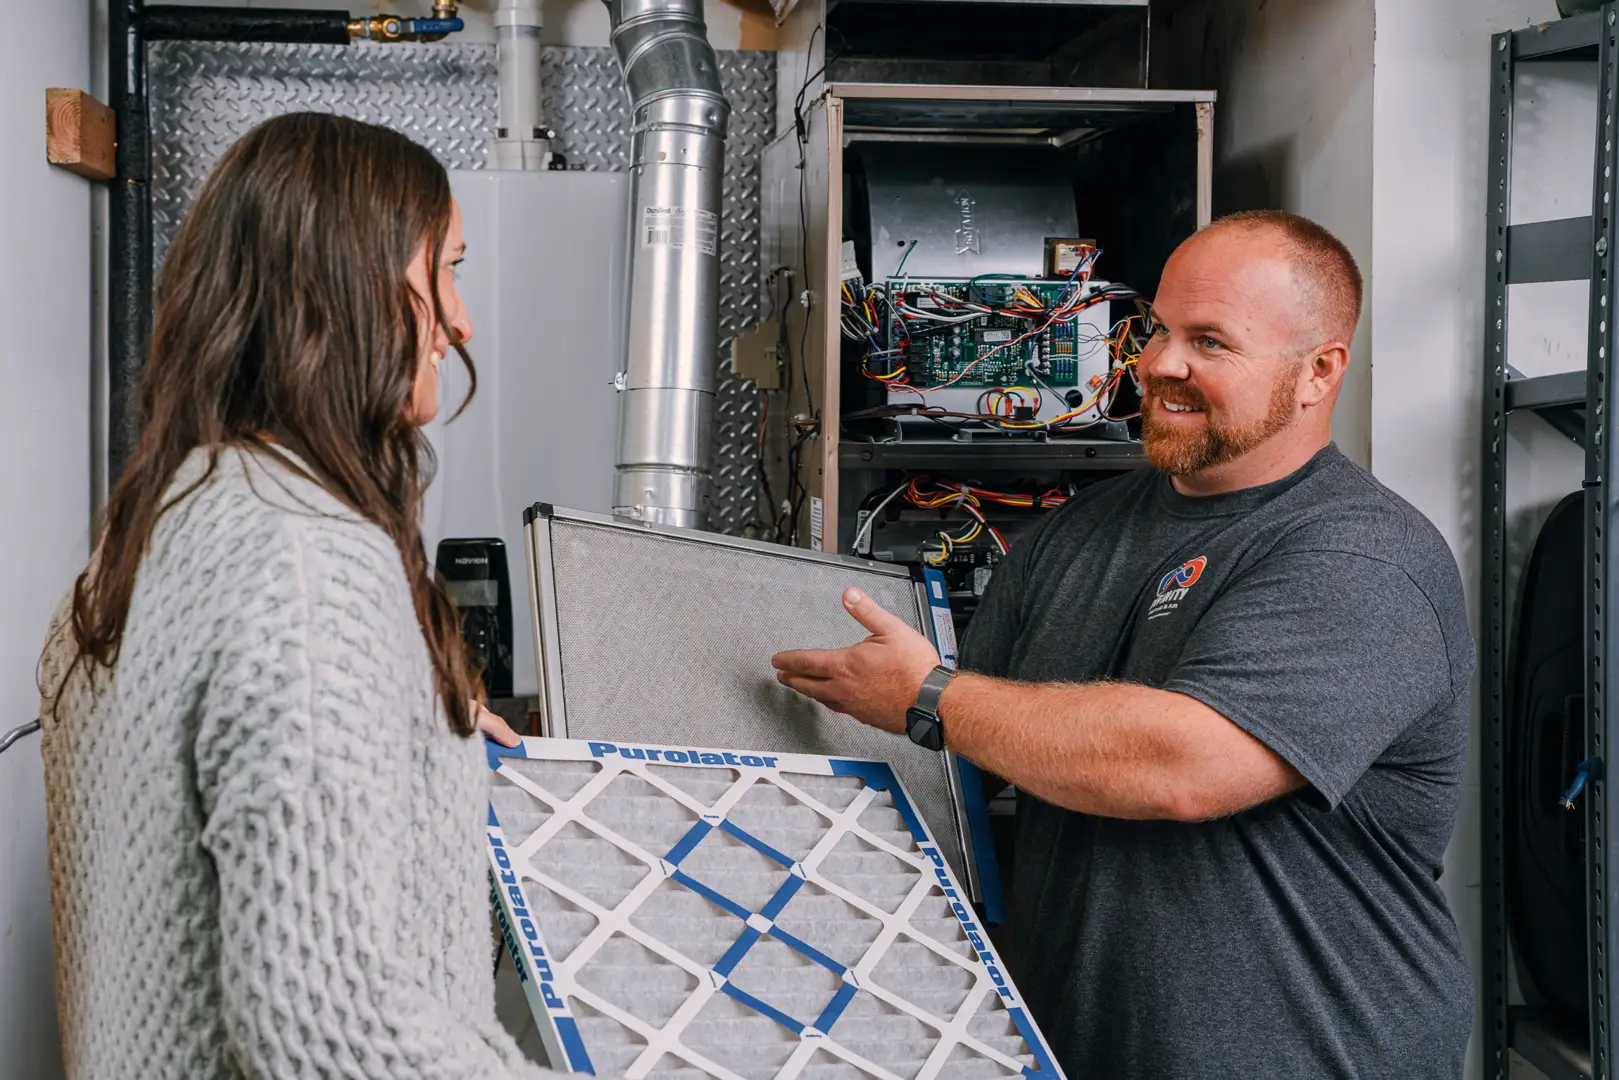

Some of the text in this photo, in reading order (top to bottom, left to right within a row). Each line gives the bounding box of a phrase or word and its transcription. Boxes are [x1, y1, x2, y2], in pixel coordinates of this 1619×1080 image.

[588, 741, 779, 768] Purolator
[487, 832, 565, 1009] Purolator
[921, 847, 1015, 1001] Purolator
